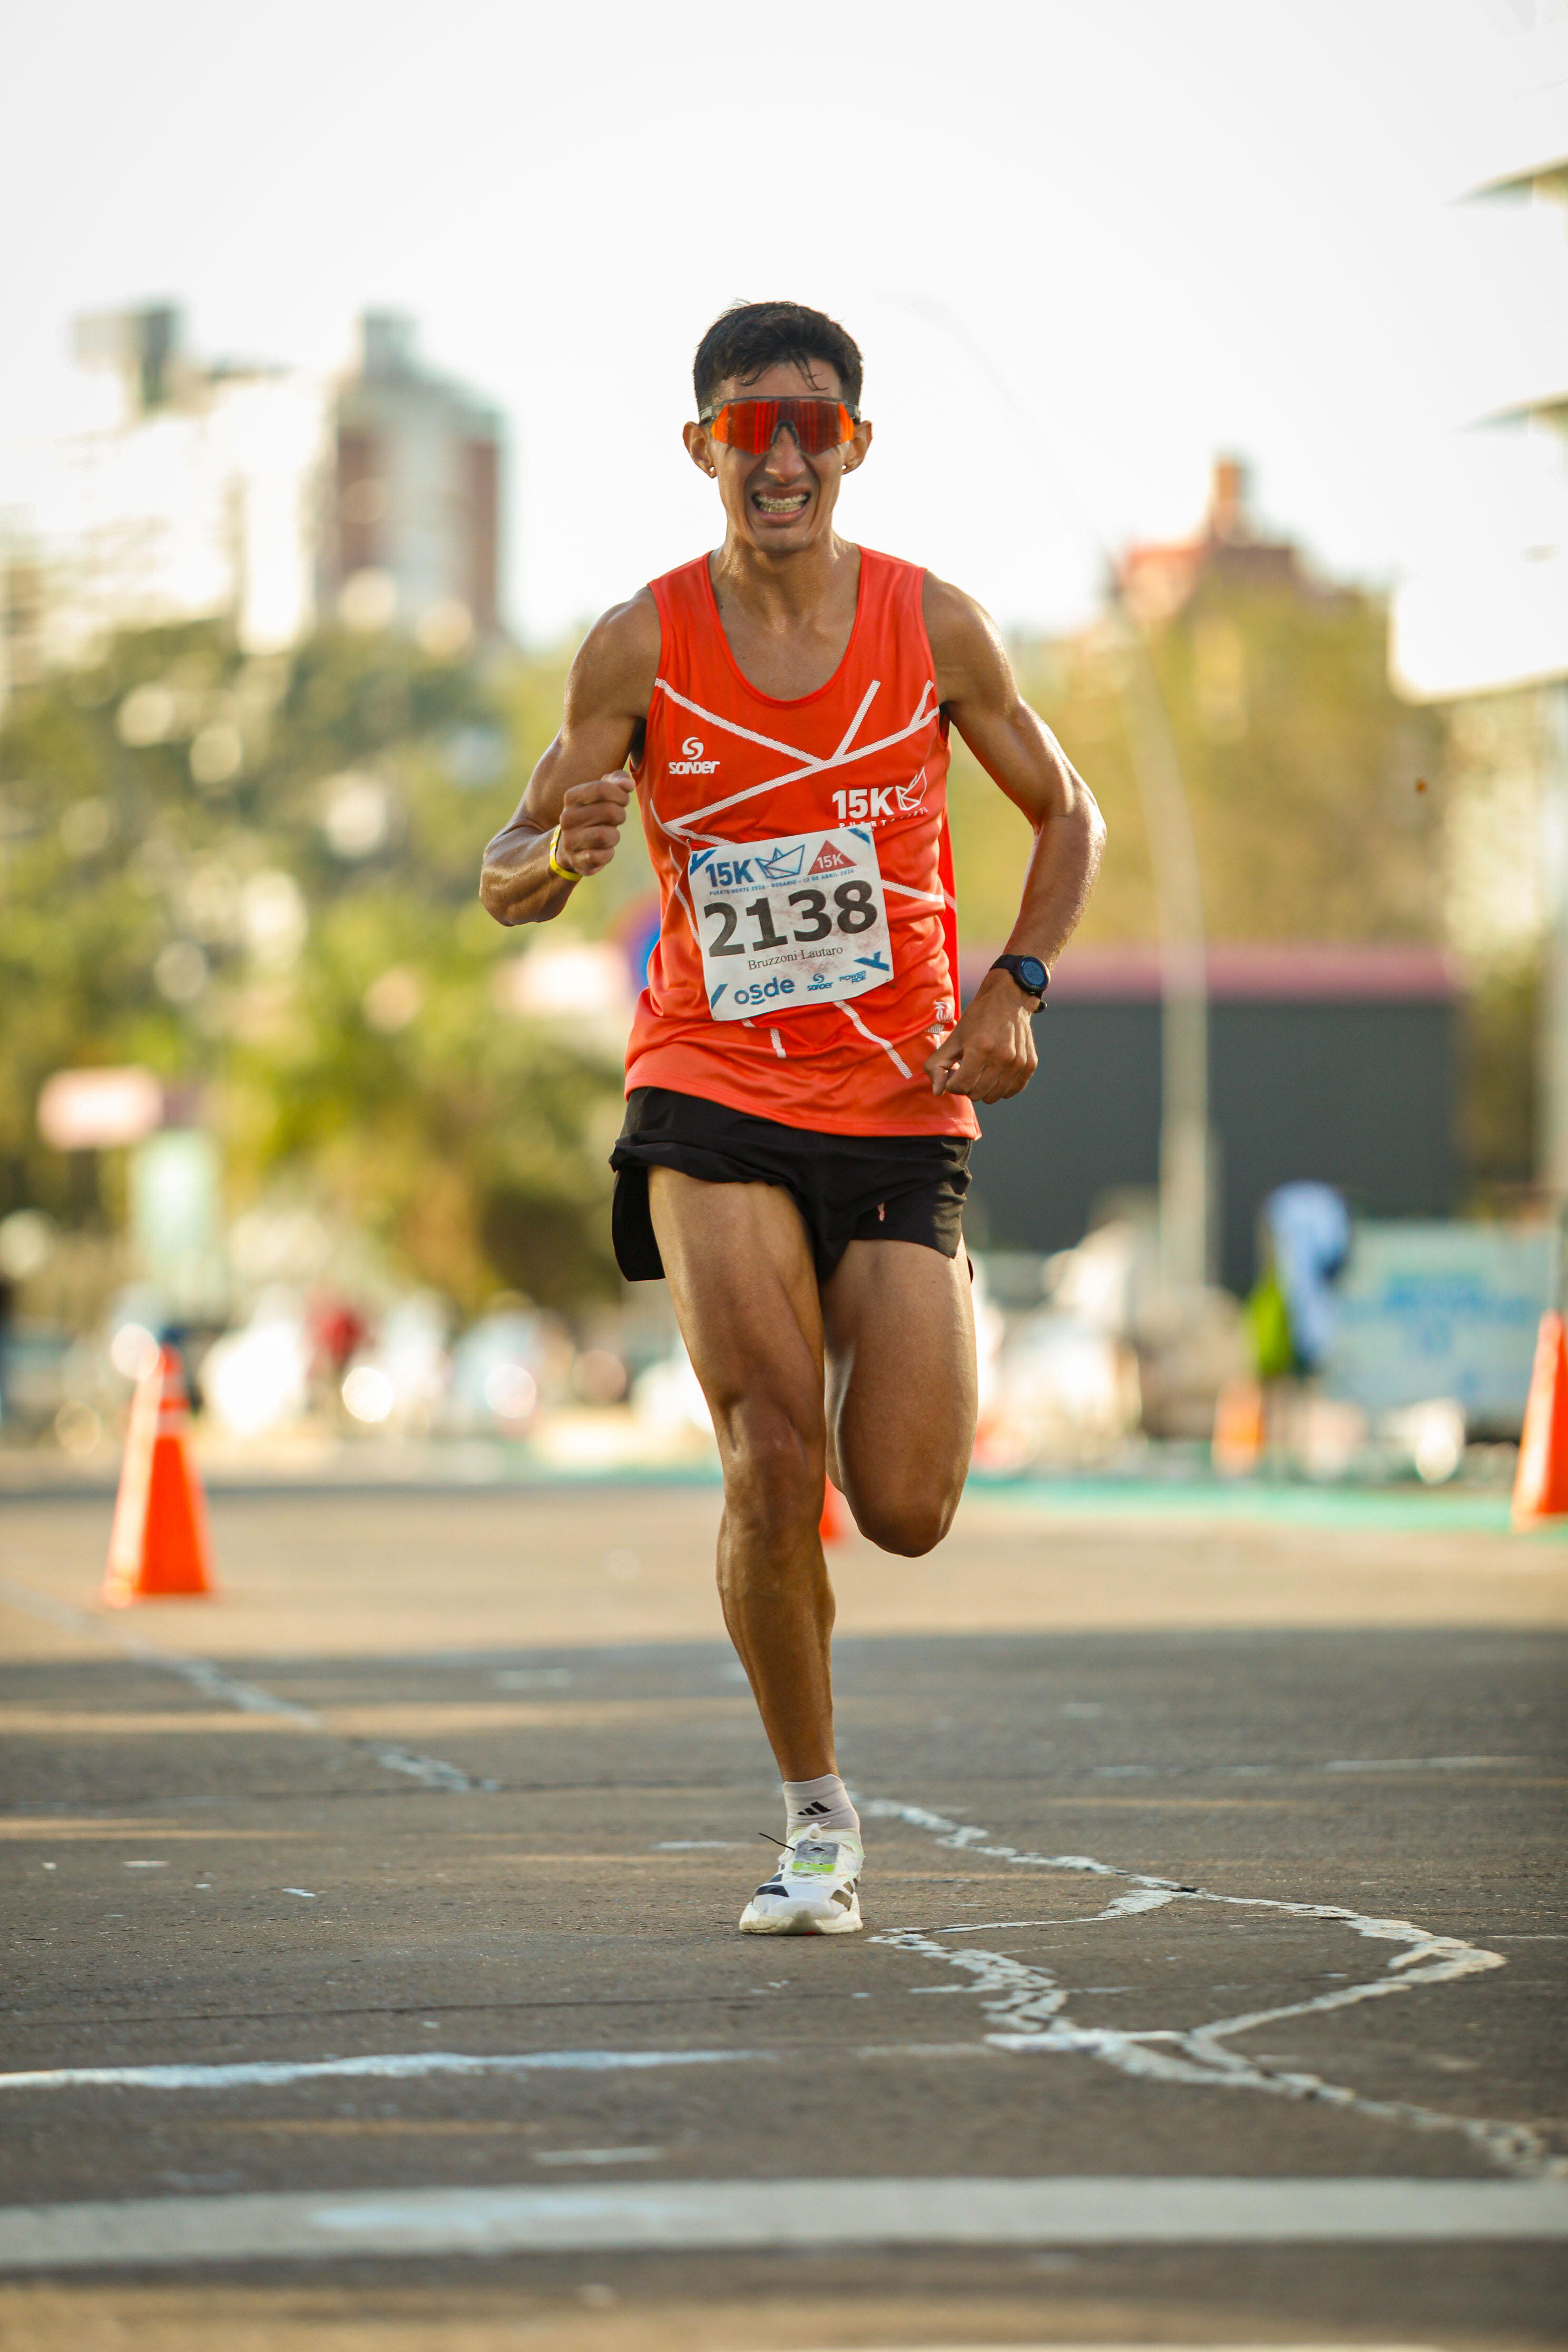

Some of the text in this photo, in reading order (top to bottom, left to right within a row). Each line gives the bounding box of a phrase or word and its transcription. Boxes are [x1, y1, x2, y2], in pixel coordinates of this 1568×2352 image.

[832, 787, 894, 819] 15K
[705, 859, 755, 887] 15K
[817, 852, 845, 869] 15K
[703, 880, 878, 957] 2138
[747, 947, 844, 971] Bruzzoni Lautaro
[839, 970, 867, 982] POWER
[734, 976, 795, 1005] osde
